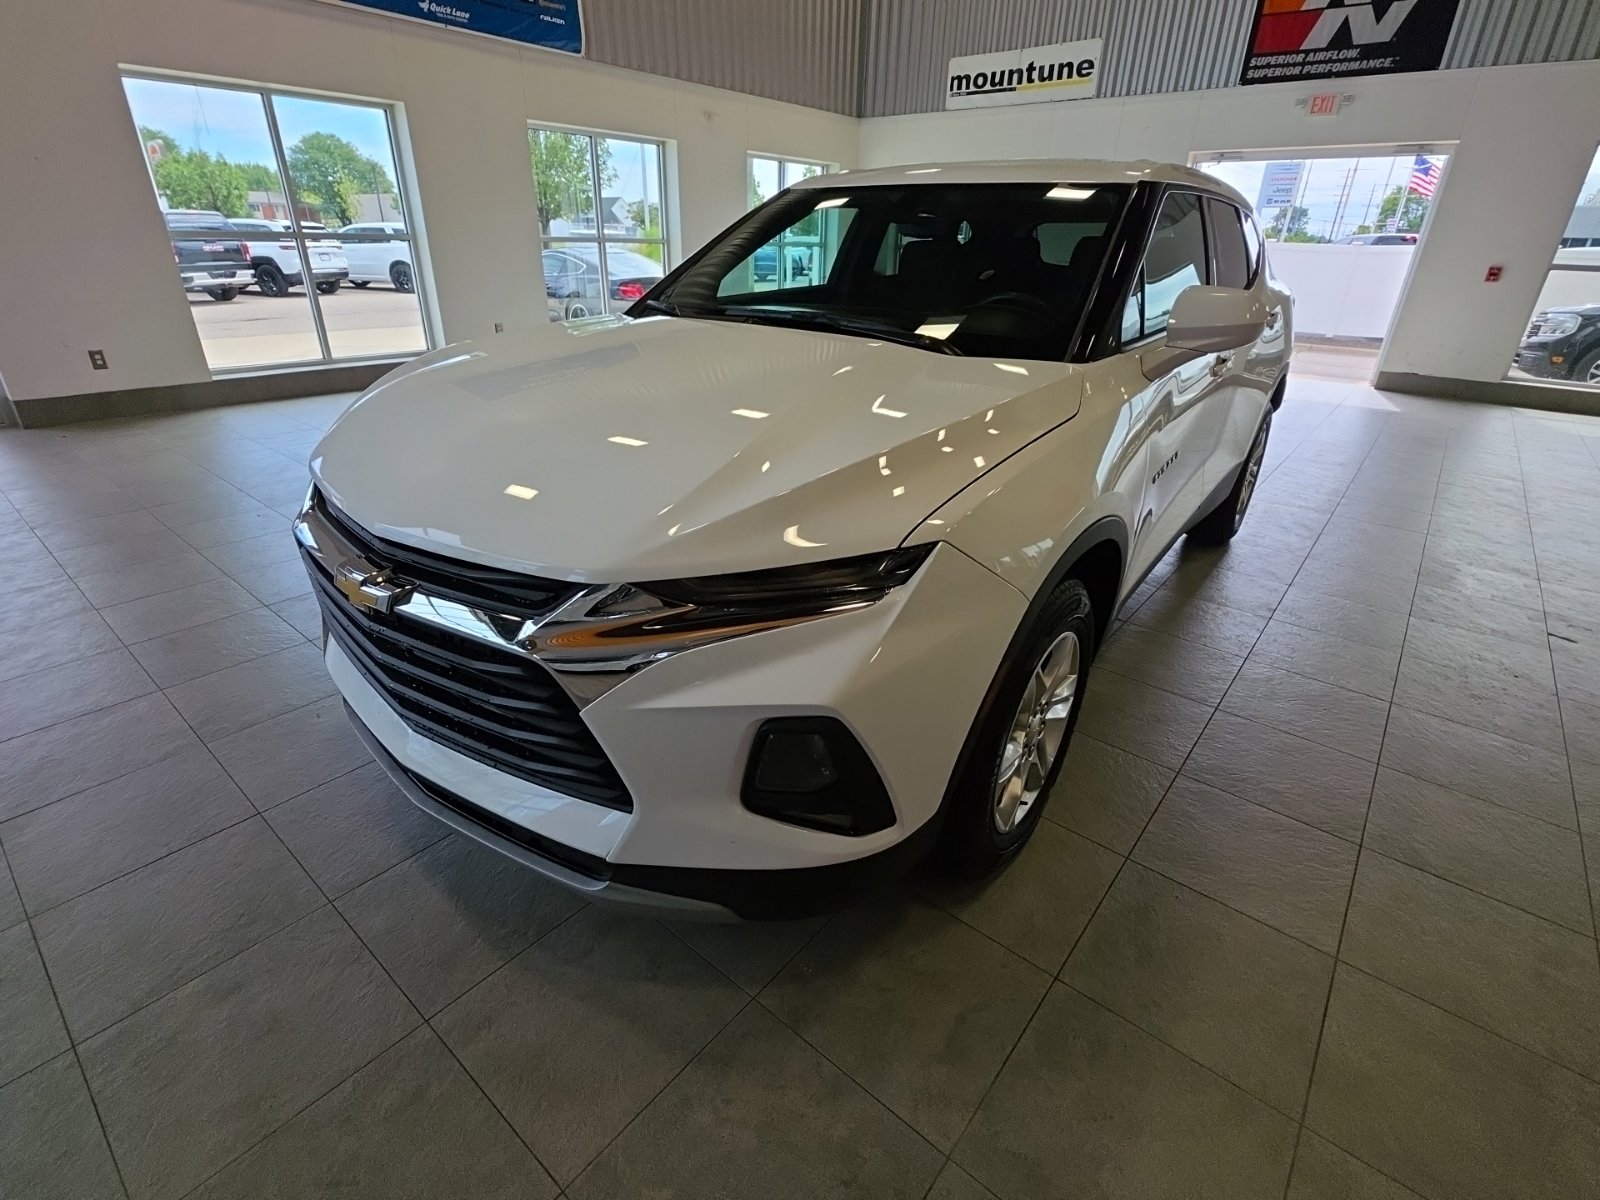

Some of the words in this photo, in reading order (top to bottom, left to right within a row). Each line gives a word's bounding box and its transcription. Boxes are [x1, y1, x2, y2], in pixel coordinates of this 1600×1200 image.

[430, 3, 451, 14] Quick
[452, 8, 469, 19] Lane
[1249, 53, 1305, 67] SUPERIOR
[1306, 48, 1361, 63] AIRFLOW.
[950, 58, 1095, 92] mountune
[1246, 65, 1302, 79] SUPERIOR
[1310, 95, 1337, 114] EXIT
